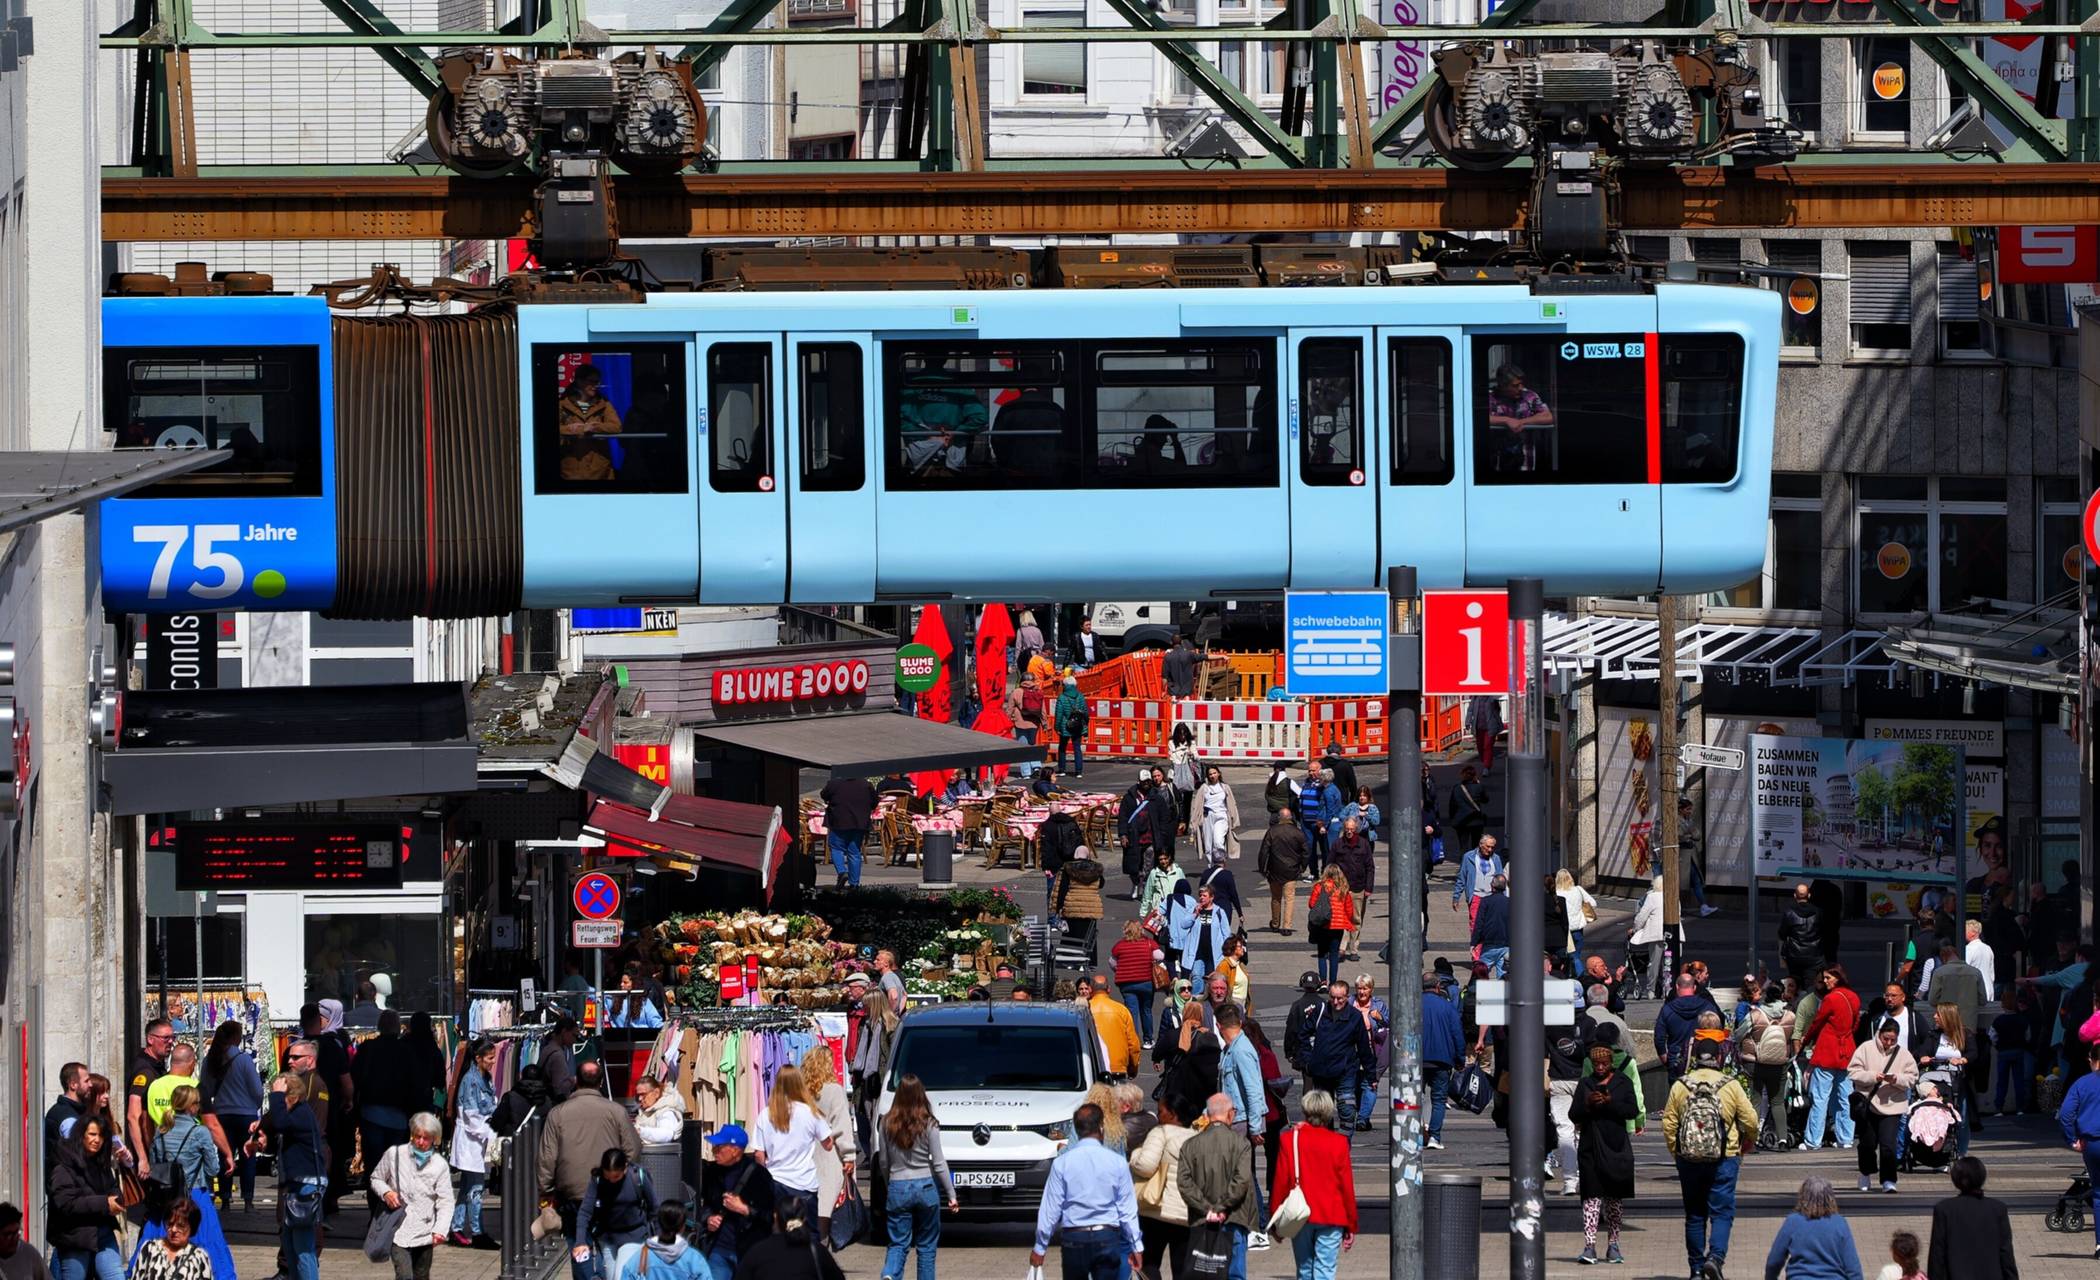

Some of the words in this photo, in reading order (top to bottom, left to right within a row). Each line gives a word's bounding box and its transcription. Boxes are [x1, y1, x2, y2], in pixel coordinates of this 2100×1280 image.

[1627, 345, 1641, 356] 28
[133, 524, 245, 600] 75
[243, 523, 298, 541] Jahre
[1292, 615, 1382, 627] schwebebahn
[899, 657, 934, 667] BLUME
[903, 666, 932, 675] 2000
[719, 670, 795, 702] BLUME
[799, 662, 868, 696] 2000
[1873, 727, 1932, 740] POMMES
[1935, 728, 1994, 741] FREUNDE
[1757, 748, 1819, 762] ZUSAMMEN
[1758, 763, 1794, 777] BAUEN
[1796, 765, 1817, 778] WIR
[1965, 771, 1999, 784] WANT
[1758, 779, 1779, 791] DAS
[1781, 780, 1811, 793] NEUE
[1965, 785, 1985, 798] OU!
[1758, 793, 1815, 808] ELBERFELD
[576, 924, 617, 934] Rettungsweg
[955, 1173, 962, 1185] D
[968, 1173, 984, 1185] PS
[985, 1173, 1015, 1185] 624E
